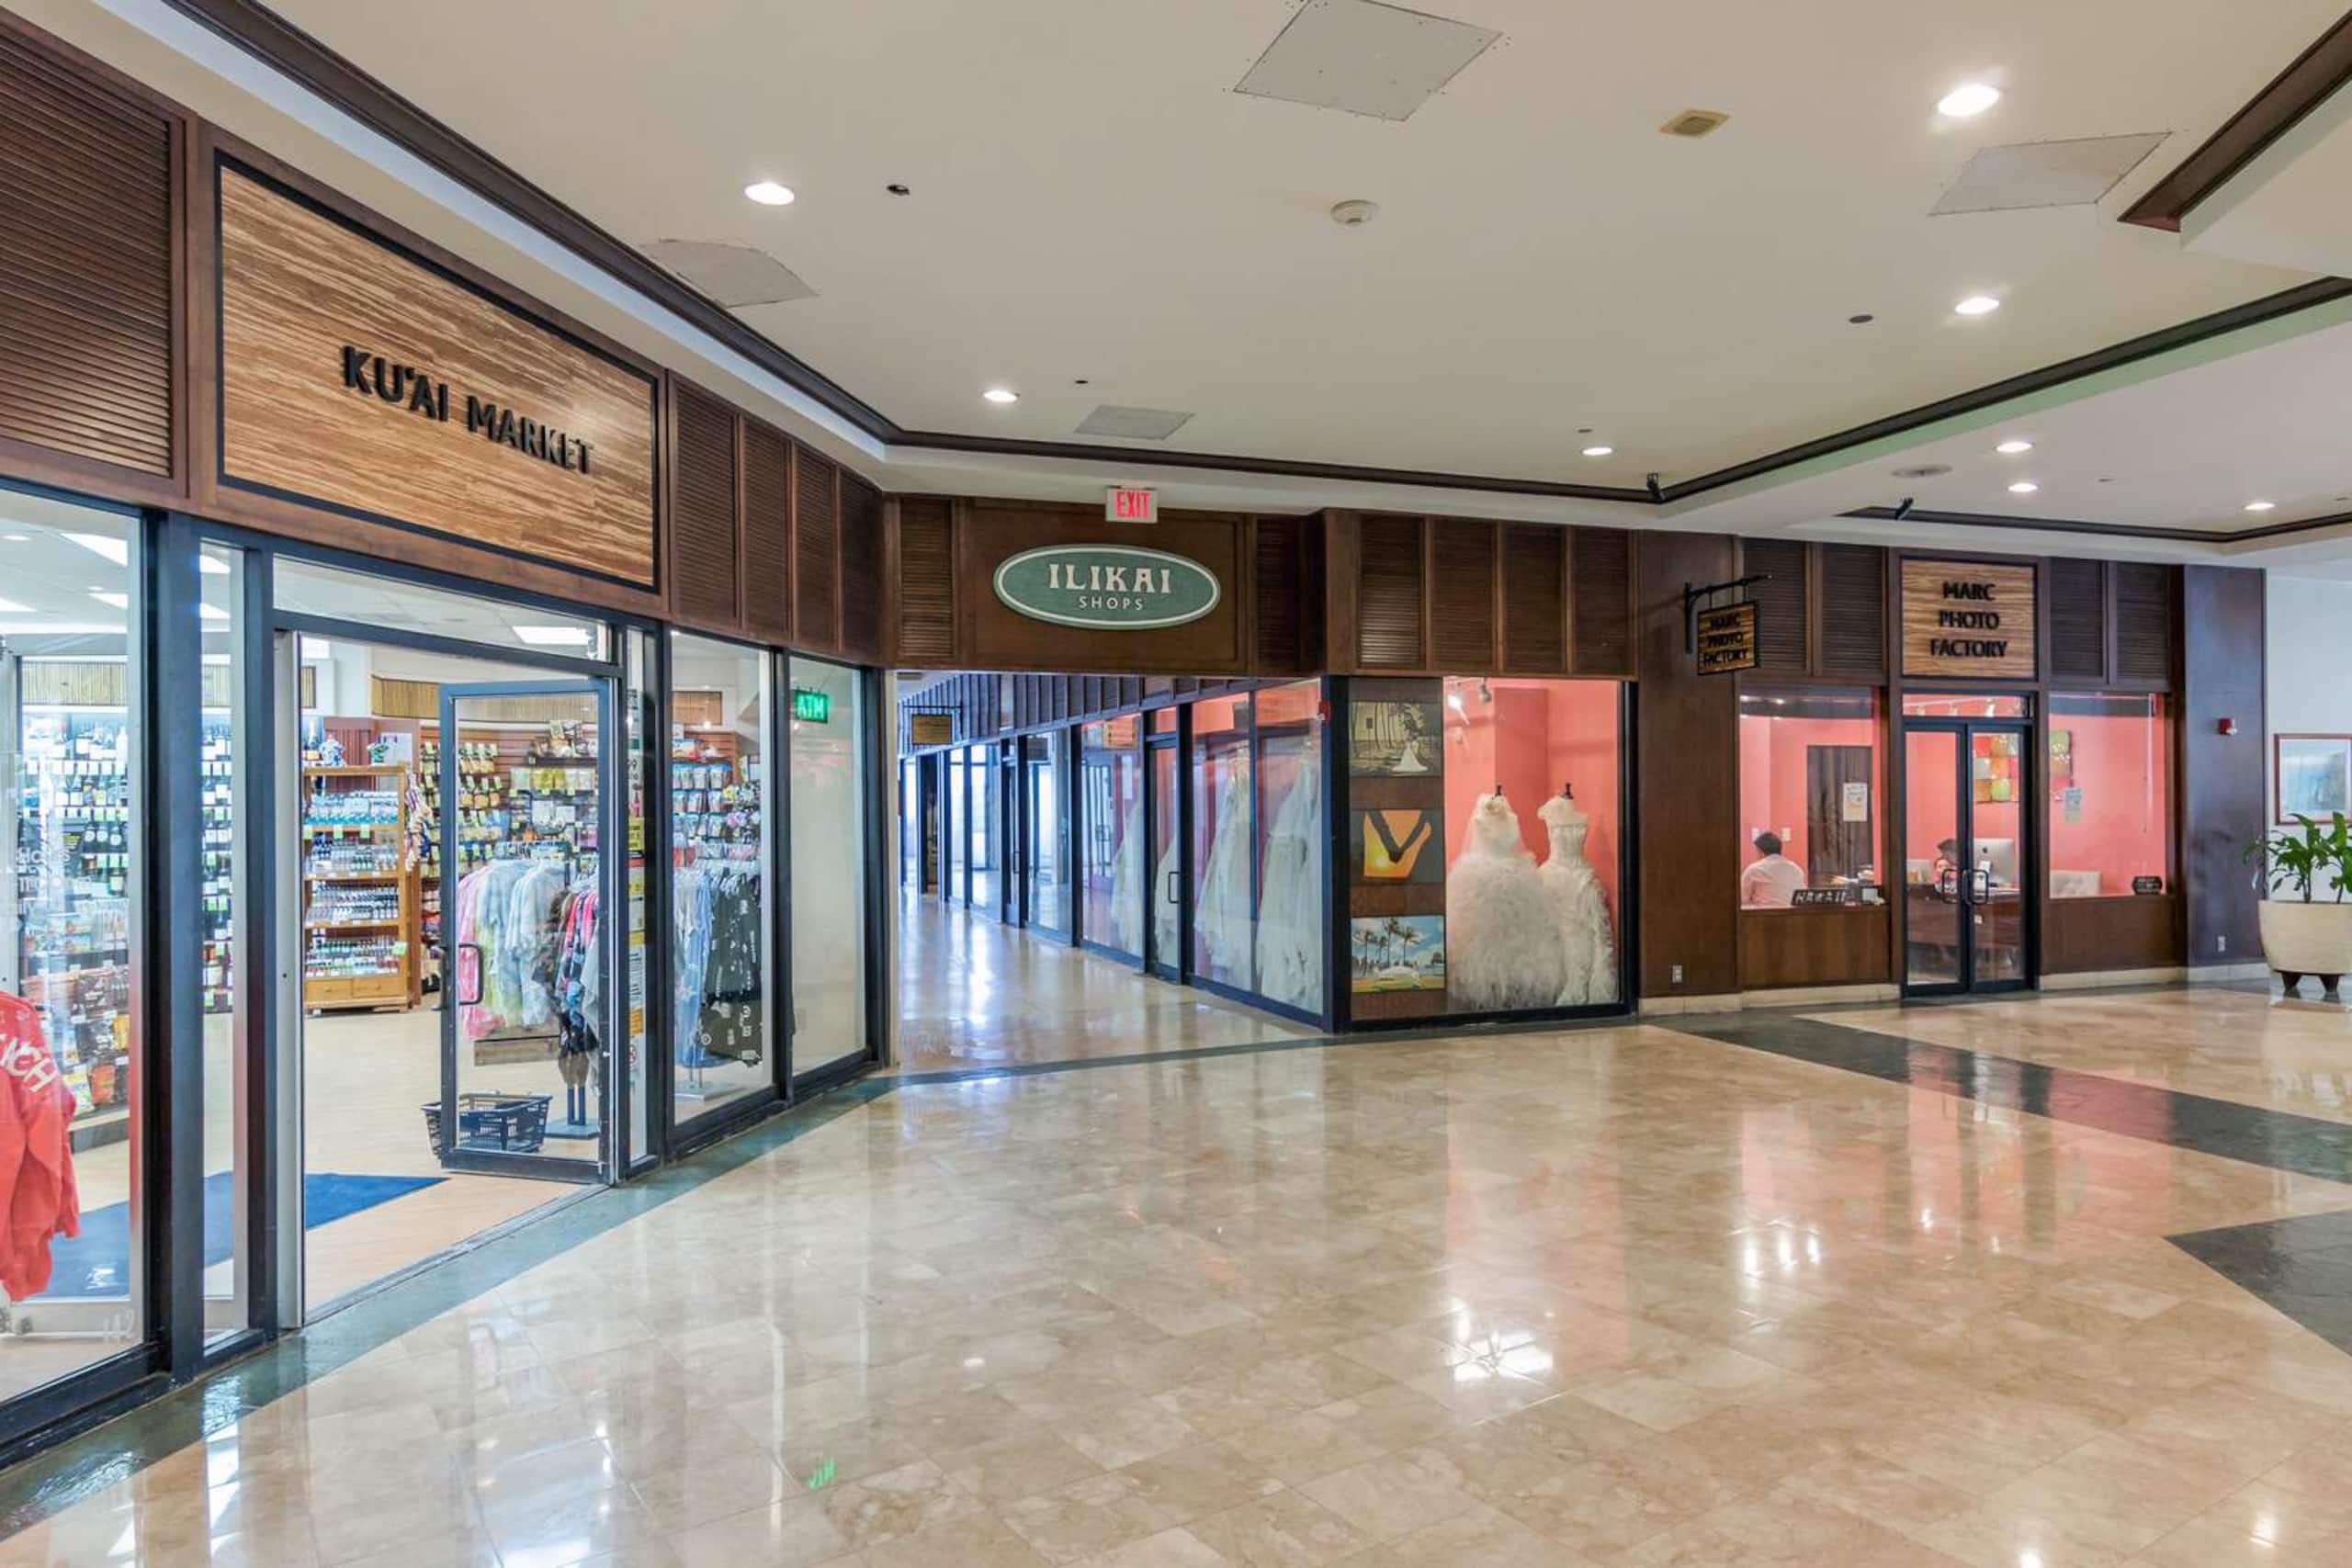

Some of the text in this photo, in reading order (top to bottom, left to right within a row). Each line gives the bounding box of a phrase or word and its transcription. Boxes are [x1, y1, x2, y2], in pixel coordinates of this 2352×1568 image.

[467, 394, 594, 474] MARKET
[1115, 491, 1151, 519] EXIT
[1048, 563, 1172, 594] ILIKAI
[1941, 580, 1996, 602] MARC
[1079, 596, 1145, 611] SHOPS
[1939, 608, 2000, 630] PHOTO
[1706, 631, 1744, 648] PHOTO
[1929, 637, 2008, 659] FACTORY
[797, 694, 825, 719] ATM
